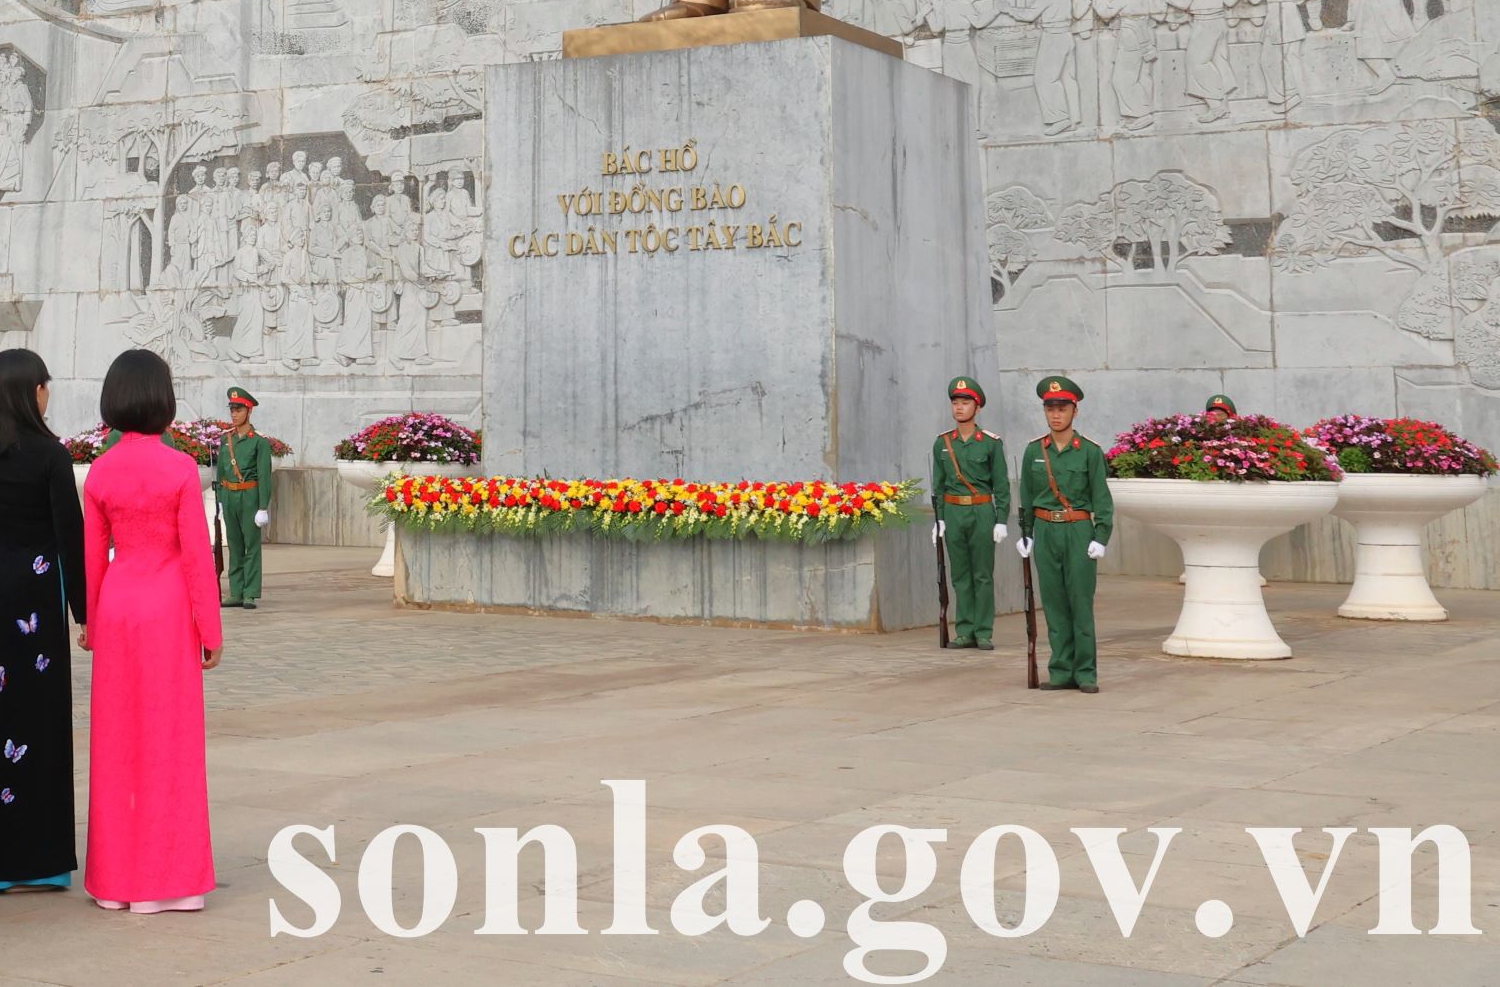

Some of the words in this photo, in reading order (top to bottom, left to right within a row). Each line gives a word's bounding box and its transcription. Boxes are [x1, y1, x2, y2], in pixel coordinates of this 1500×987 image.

[601, 145, 653, 175] BÁC
[658, 137, 698, 173] HỒ
[557, 186, 603, 216] VỚI
[608, 179, 684, 215] ĐỒNG
[690, 178, 746, 212] BÀO
[508, 228, 560, 259] CÁC
[565, 225, 619, 256] DÂN
[624, 222, 680, 259] TỘC
[685, 219, 740, 252] TÂY
[745, 214, 803, 250] BẮC
